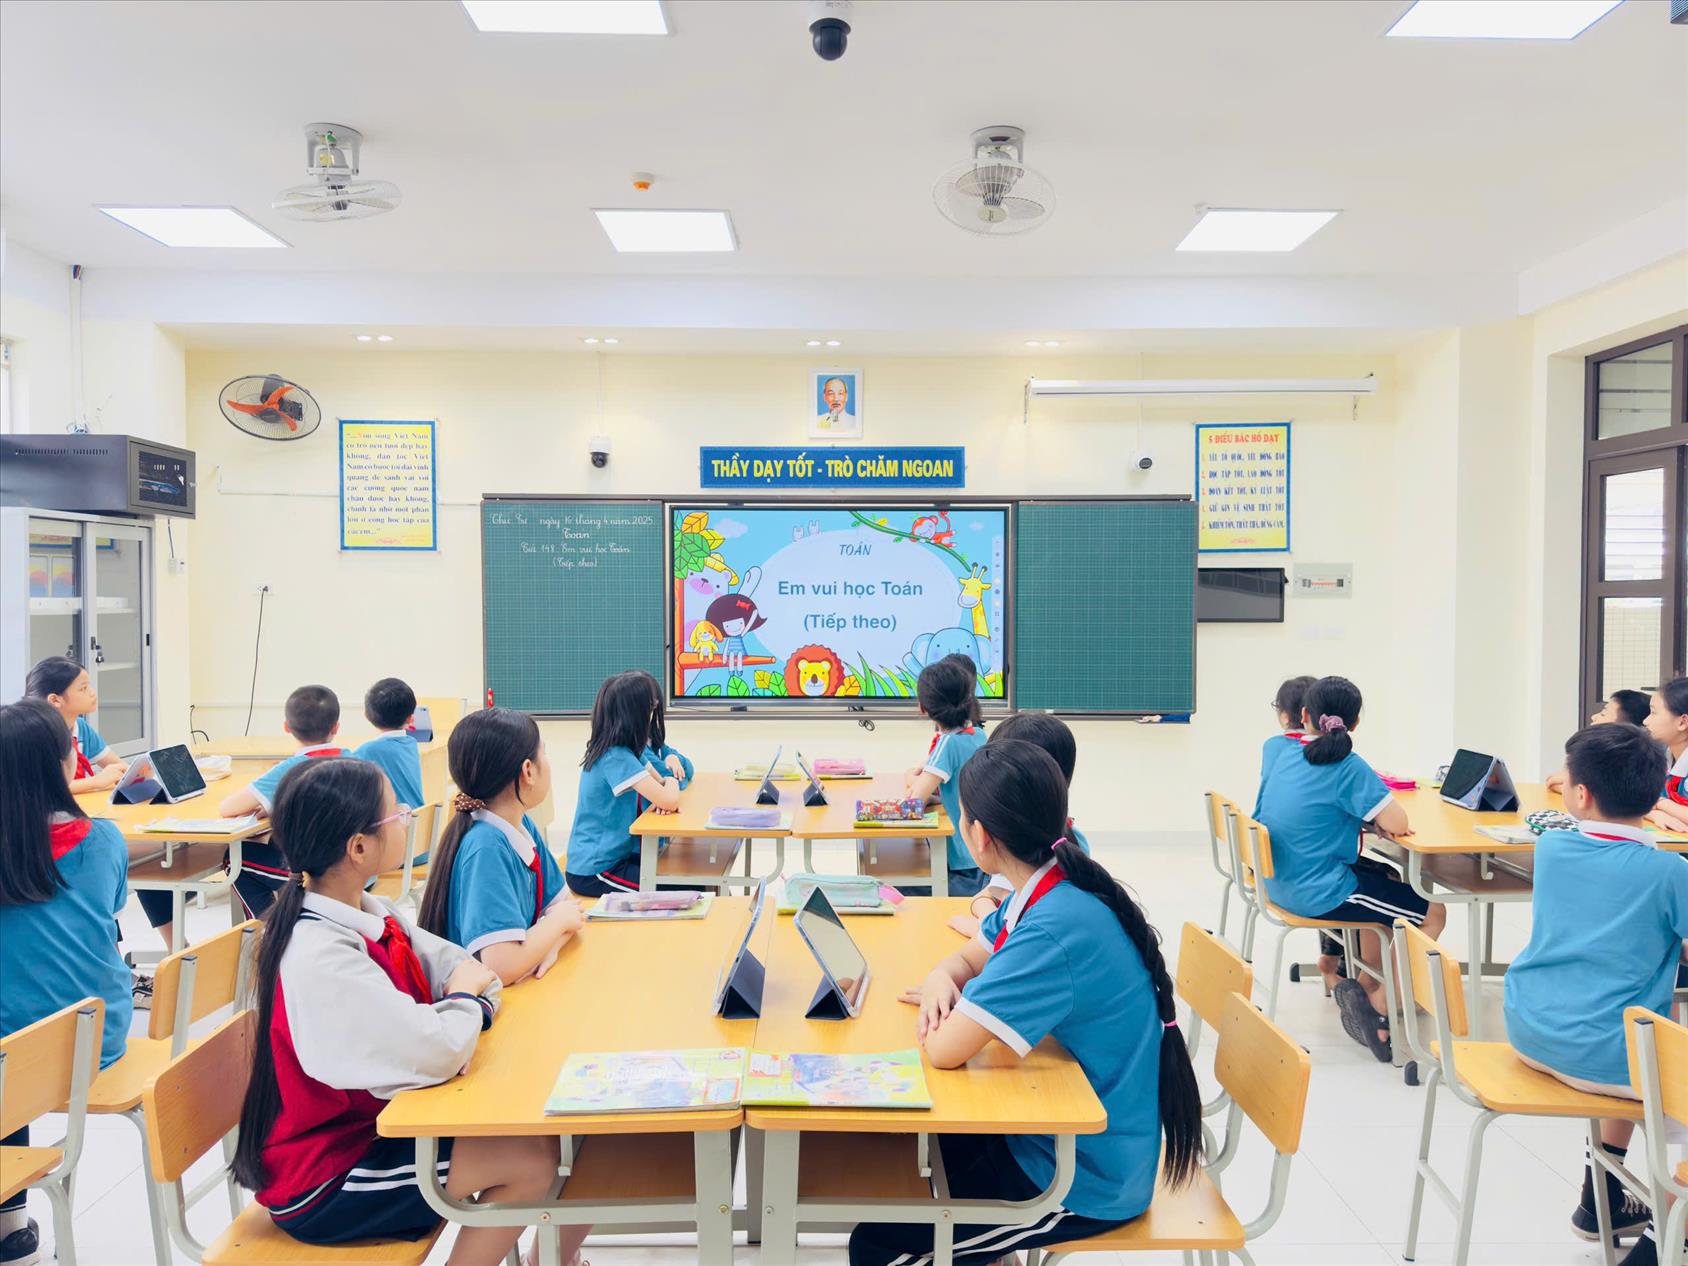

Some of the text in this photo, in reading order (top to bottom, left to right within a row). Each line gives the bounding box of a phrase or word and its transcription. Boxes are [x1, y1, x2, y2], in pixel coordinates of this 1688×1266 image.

[412, 432, 429, 440] Nam
[1208, 435, 1213, 443] 5
[712, 452, 750, 478] THẦY
[753, 459, 783, 483] DẠY
[787, 452, 815, 478] TỐT
[825, 455, 853, 478] TRÒ
[856, 453, 899, 478] CHĂM
[902, 459, 954, 478] NGOAN
[631, 514, 653, 525] 2025
[561, 543, 577, 553] Em
[839, 541, 872, 556] TOÁN
[778, 580, 924, 600] Em vui học Toán
[803, 612, 897, 633] (Tiếp theo)
